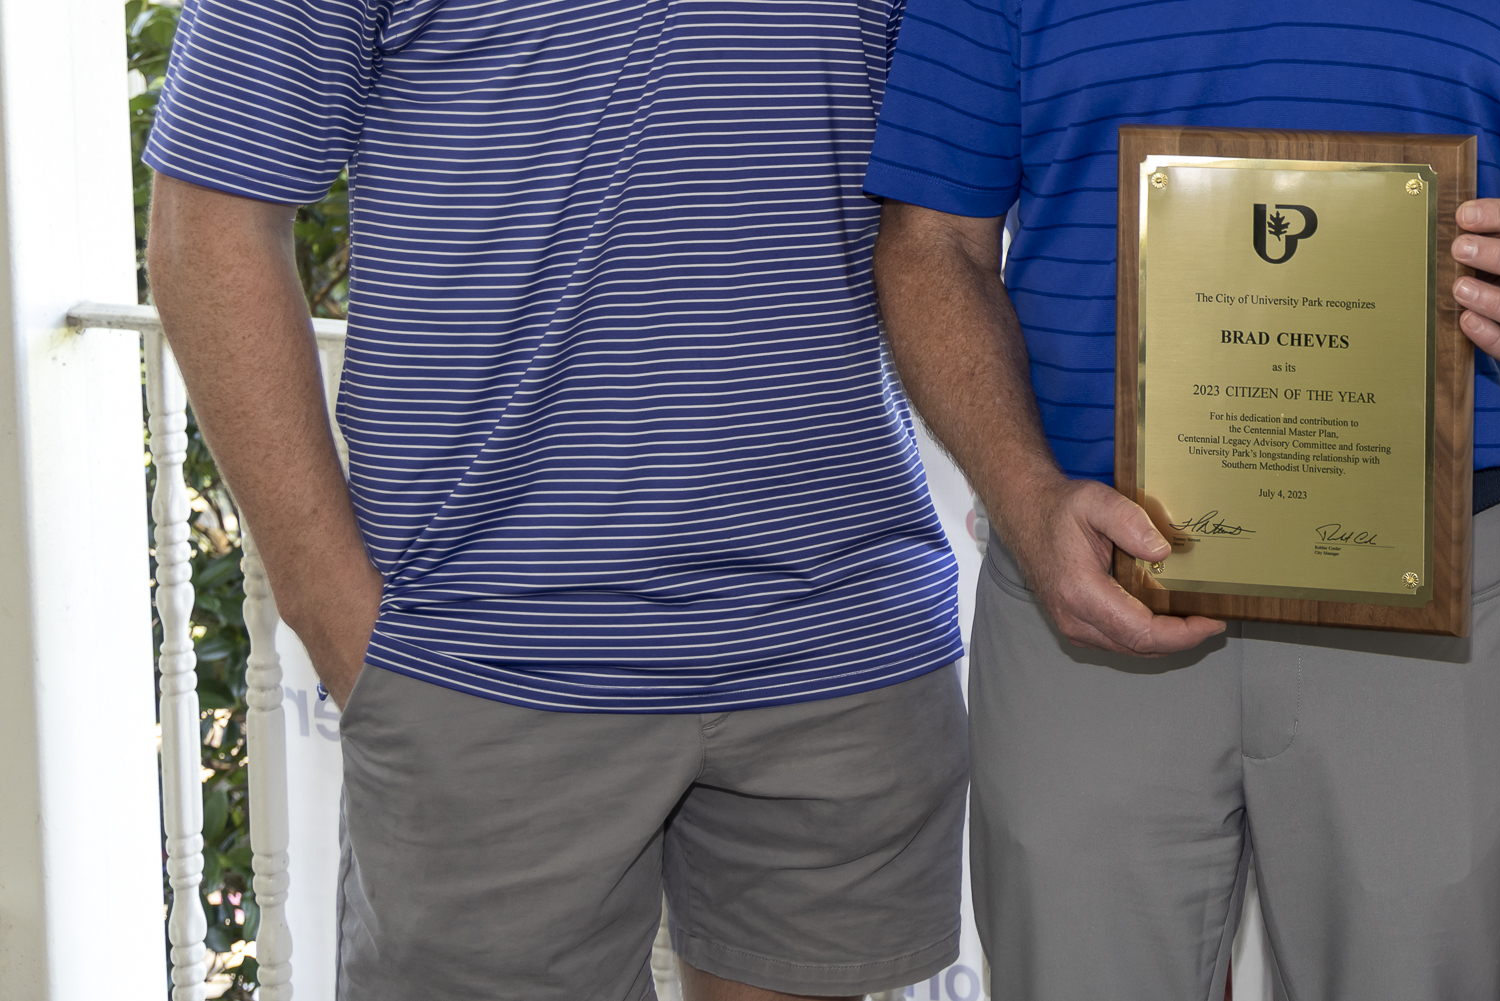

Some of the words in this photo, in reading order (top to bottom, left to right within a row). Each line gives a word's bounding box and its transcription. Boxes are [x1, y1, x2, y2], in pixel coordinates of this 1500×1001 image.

[1195, 292, 1213, 303] The
[1215, 293, 1236, 306] City
[1238, 294, 1249, 304] of
[1250, 295, 1300, 308] University
[1302, 297, 1323, 308] Park
[1325, 298, 1376, 311] recognizes
[1220, 330, 1270, 346] BRAD
[1276, 332, 1350, 349] CHEVES
[1272, 363, 1283, 372] as
[1284, 362, 1296, 373] its
[1192, 384, 1220, 396] 2023
[1225, 386, 1279, 399] CITIZEN
[1283, 389, 1302, 400] OF
[1306, 389, 1334, 402] THE
[1337, 391, 1376, 404] YEAR
[1209, 412, 1224, 421] For
[1225, 412, 1238, 421] his
[1239, 413, 1281, 424] dedication
[1282, 415, 1298, 425] and
[1299, 416, 1349, 427] contribution
[1350, 419, 1359, 428] to
[1229, 425, 1242, 434] the
[1243, 425, 1287, 436] Centennial
[1288, 428, 1316, 437] Master
[1318, 429, 1339, 439] Plan,
[1177, 433, 1220, 444] Centennial
[1222, 435, 1252, 448] Legacy
[1253, 437, 1290, 450] Advisory
[1292, 439, 1337, 451] Committee
[1338, 442, 1354, 452] and
[1355, 443, 1392, 455] fostering
[1188, 446, 1230, 458] University
[1259, 449, 1311, 462] longstanding
[1312, 452, 1360, 465] relationship
[1361, 455, 1381, 465] with
[1221, 460, 1258, 470] Southern
[1259, 462, 1300, 473] Methodist
[1301, 464, 1346, 476] University.
[1258, 488, 1276, 500] July
[1277, 490, 1286, 500] 4,
[1287, 490, 1308, 500] 2023
